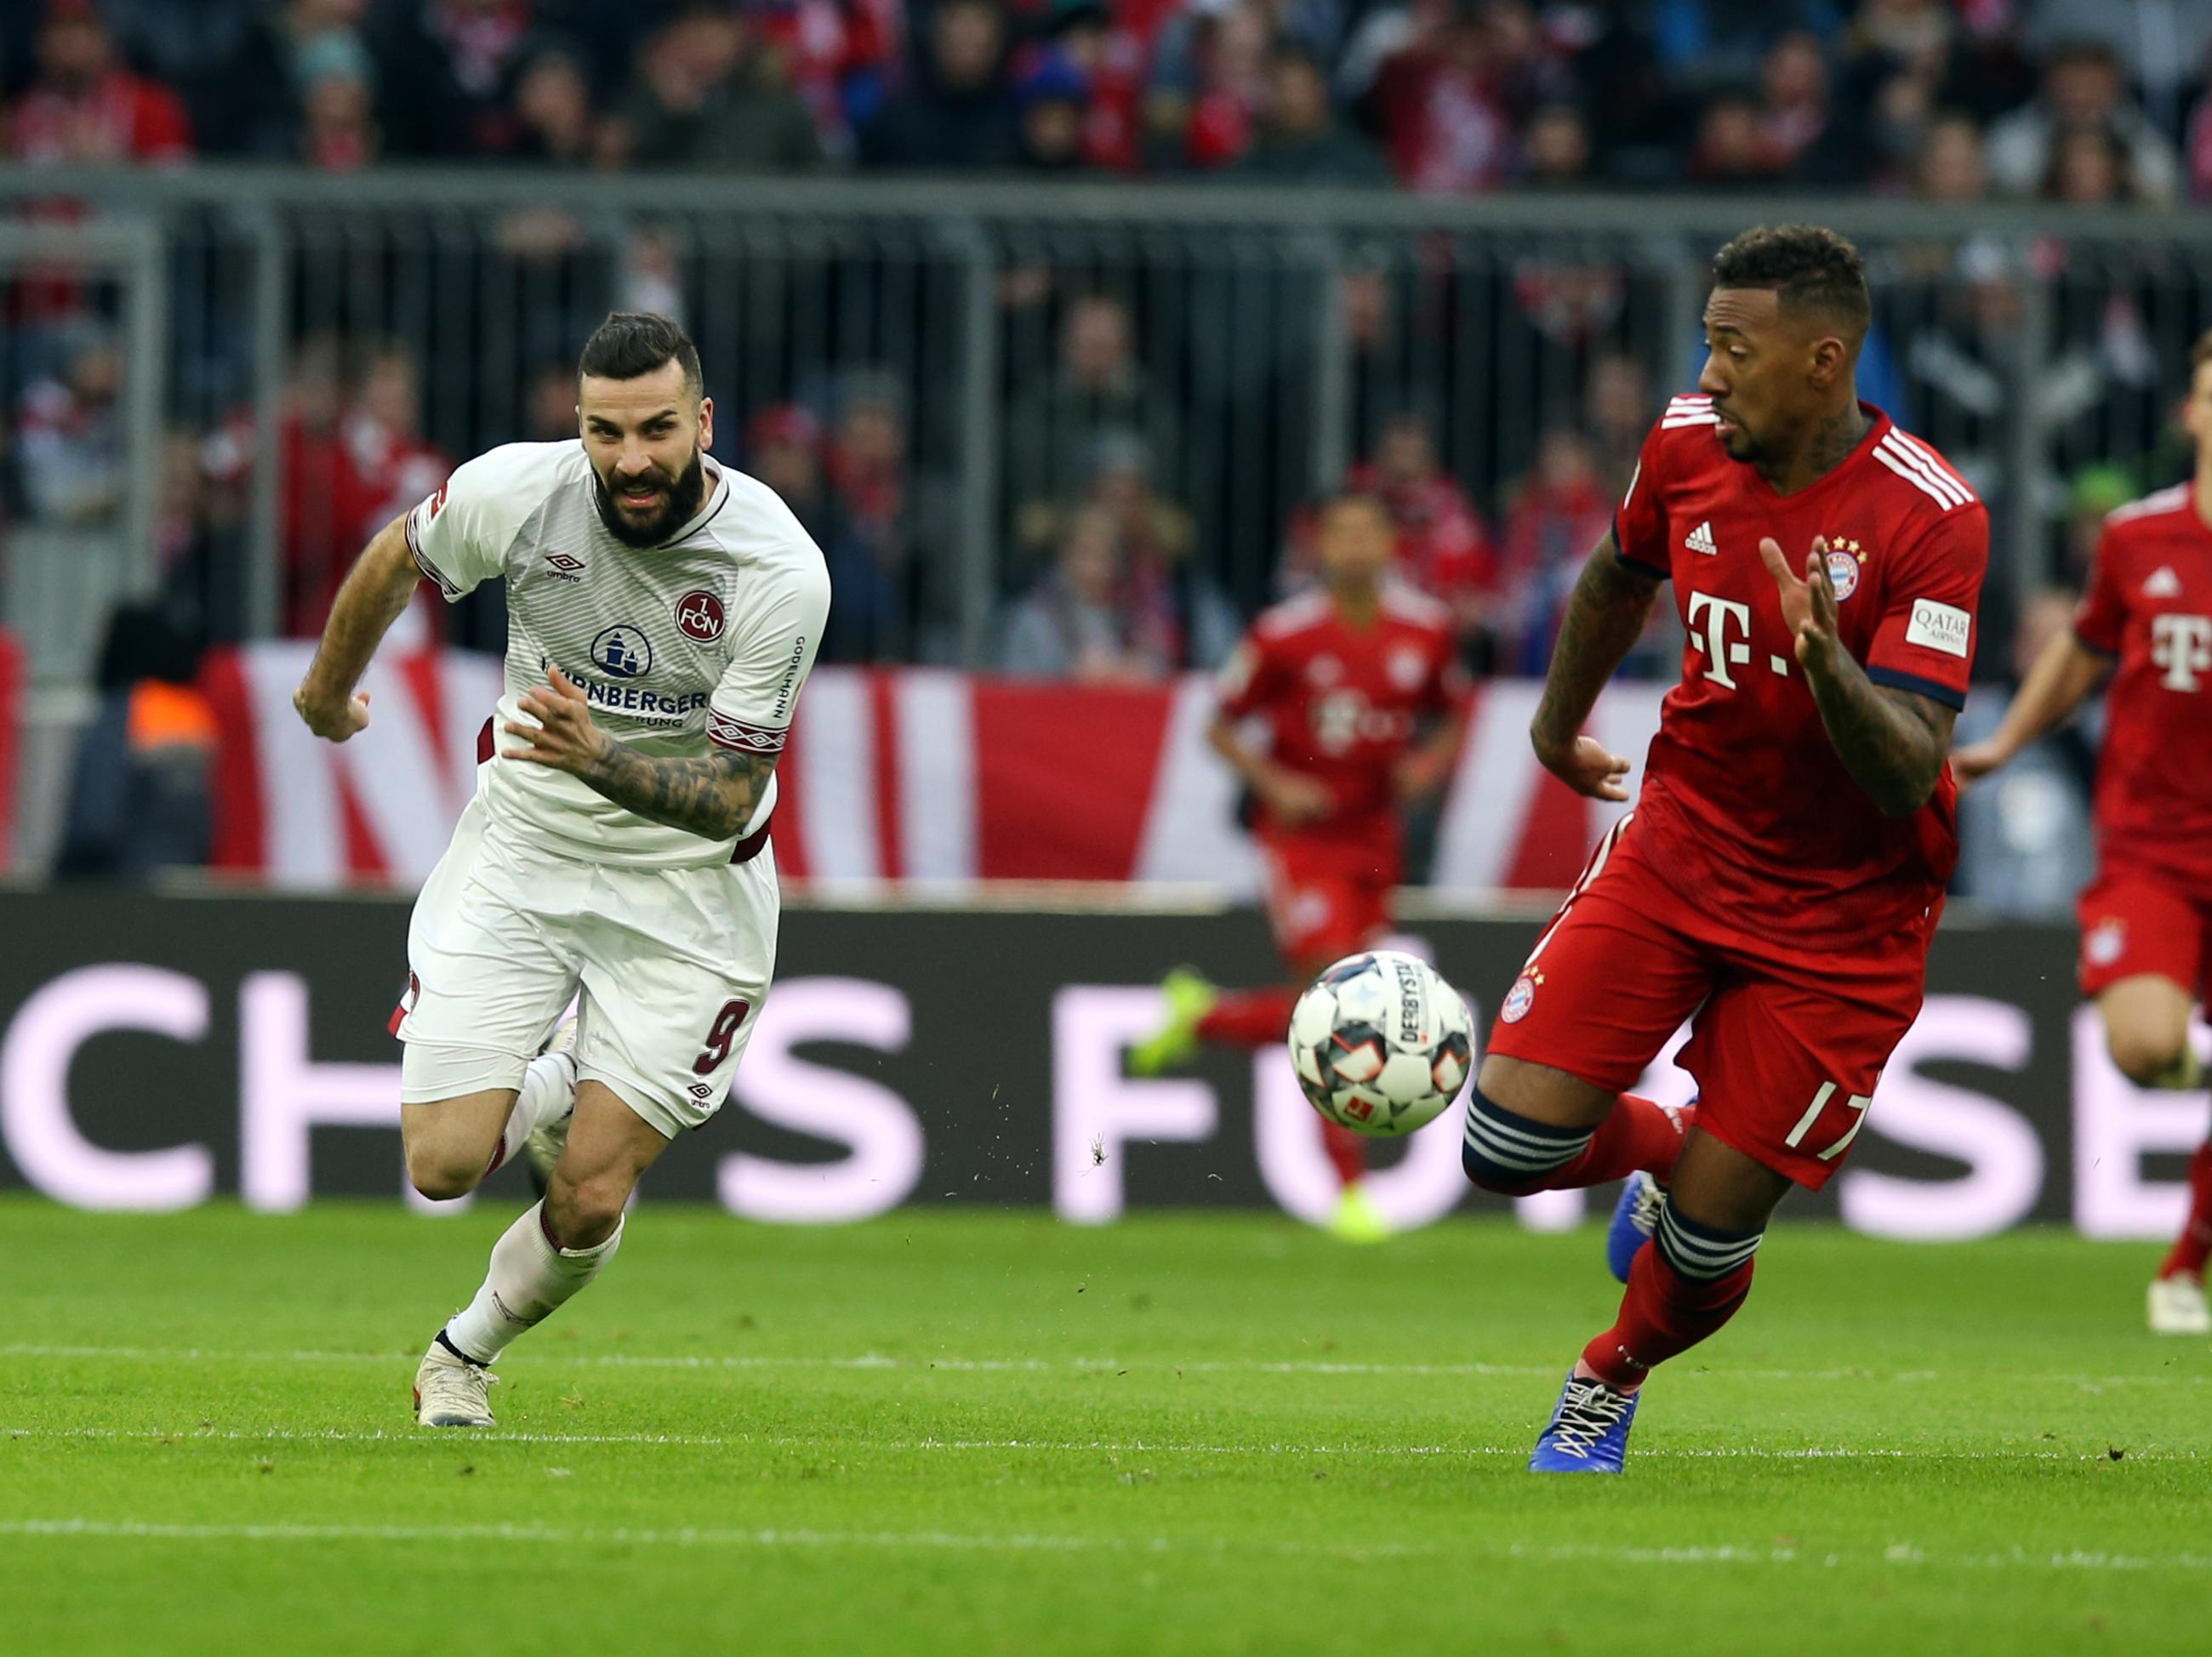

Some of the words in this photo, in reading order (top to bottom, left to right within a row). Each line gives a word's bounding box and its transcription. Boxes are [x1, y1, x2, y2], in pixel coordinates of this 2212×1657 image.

[546, 571, 580, 583] umbro
[681, 607, 719, 635] FCN
[1915, 608, 1967, 638] QATAR
[541, 656, 707, 715] RNBERGER
[772, 636, 806, 719] GODELMANN
[692, 998, 750, 1076] 9
[0, 963, 926, 1227] CHS
[1785, 1080, 1872, 1161] 17
